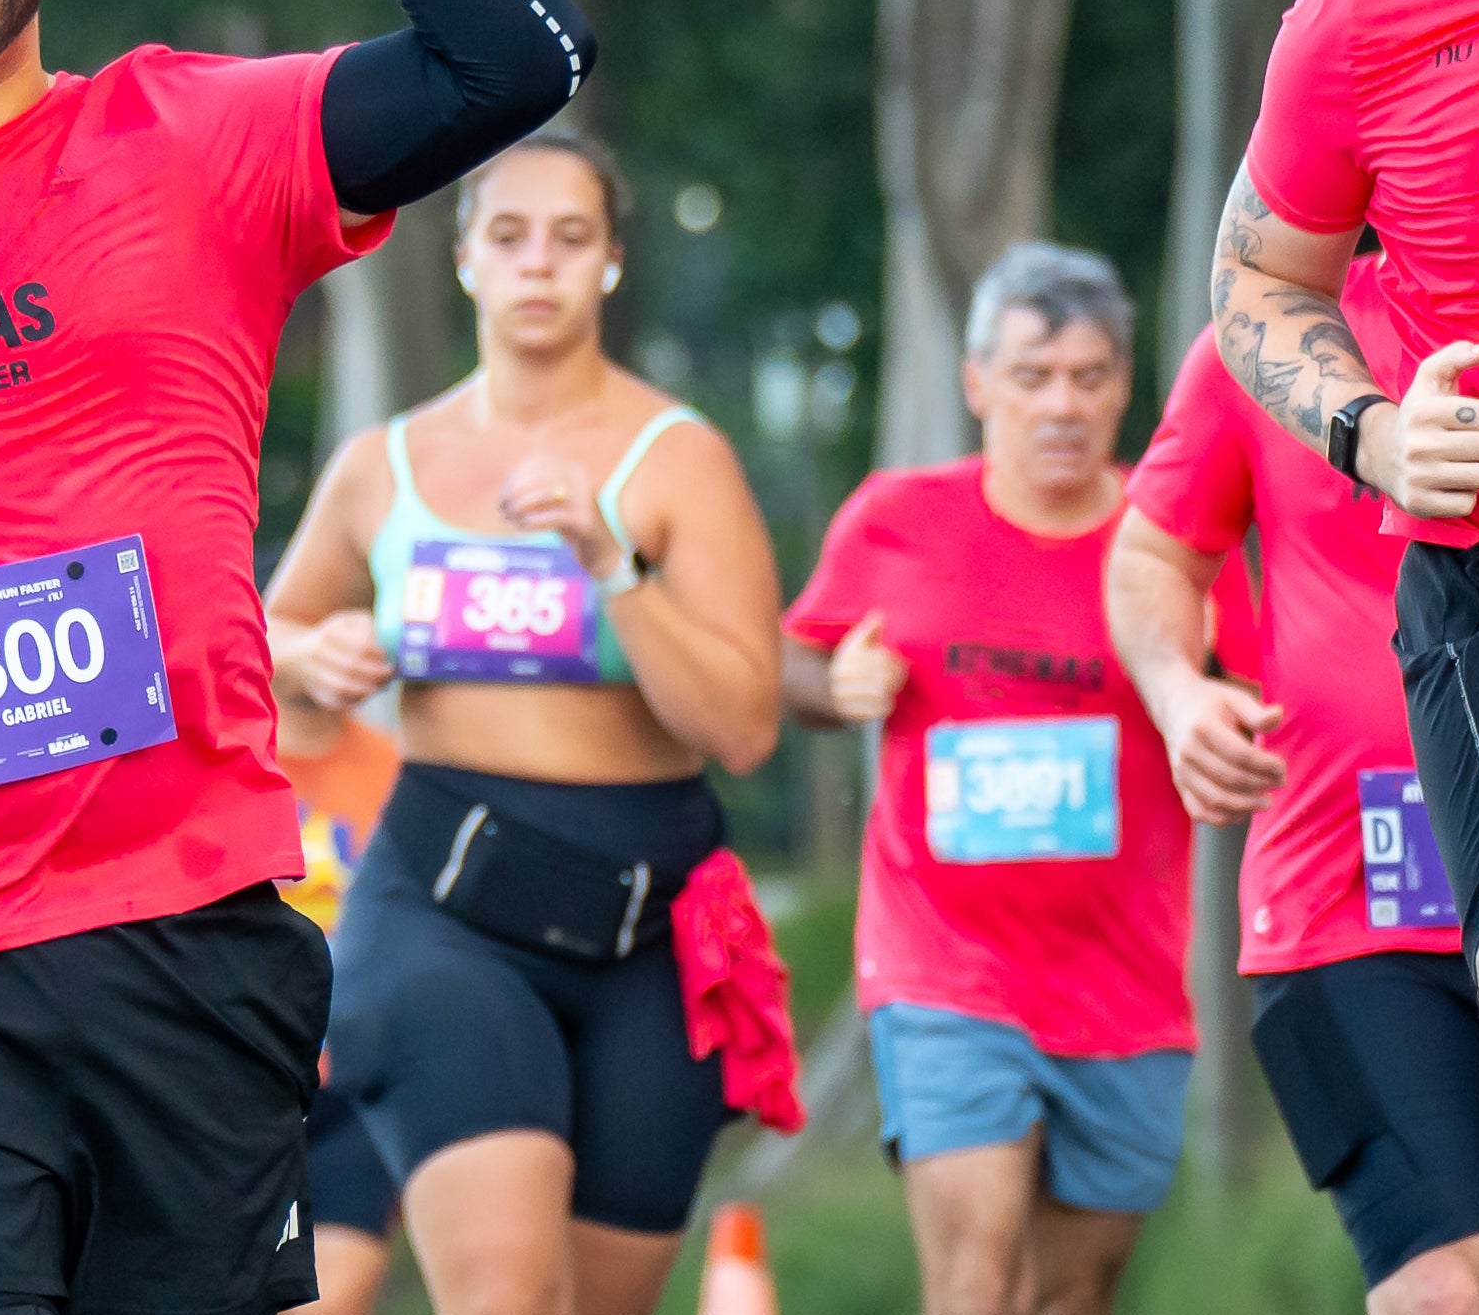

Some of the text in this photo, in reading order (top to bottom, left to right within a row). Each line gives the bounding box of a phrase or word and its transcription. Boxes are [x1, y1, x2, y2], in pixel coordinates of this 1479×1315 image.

[19, 578, 62, 596] FASTER
[461, 574, 568, 636] 365
[1, 696, 72, 726] GABRIEL
[1372, 817, 1393, 855] D
